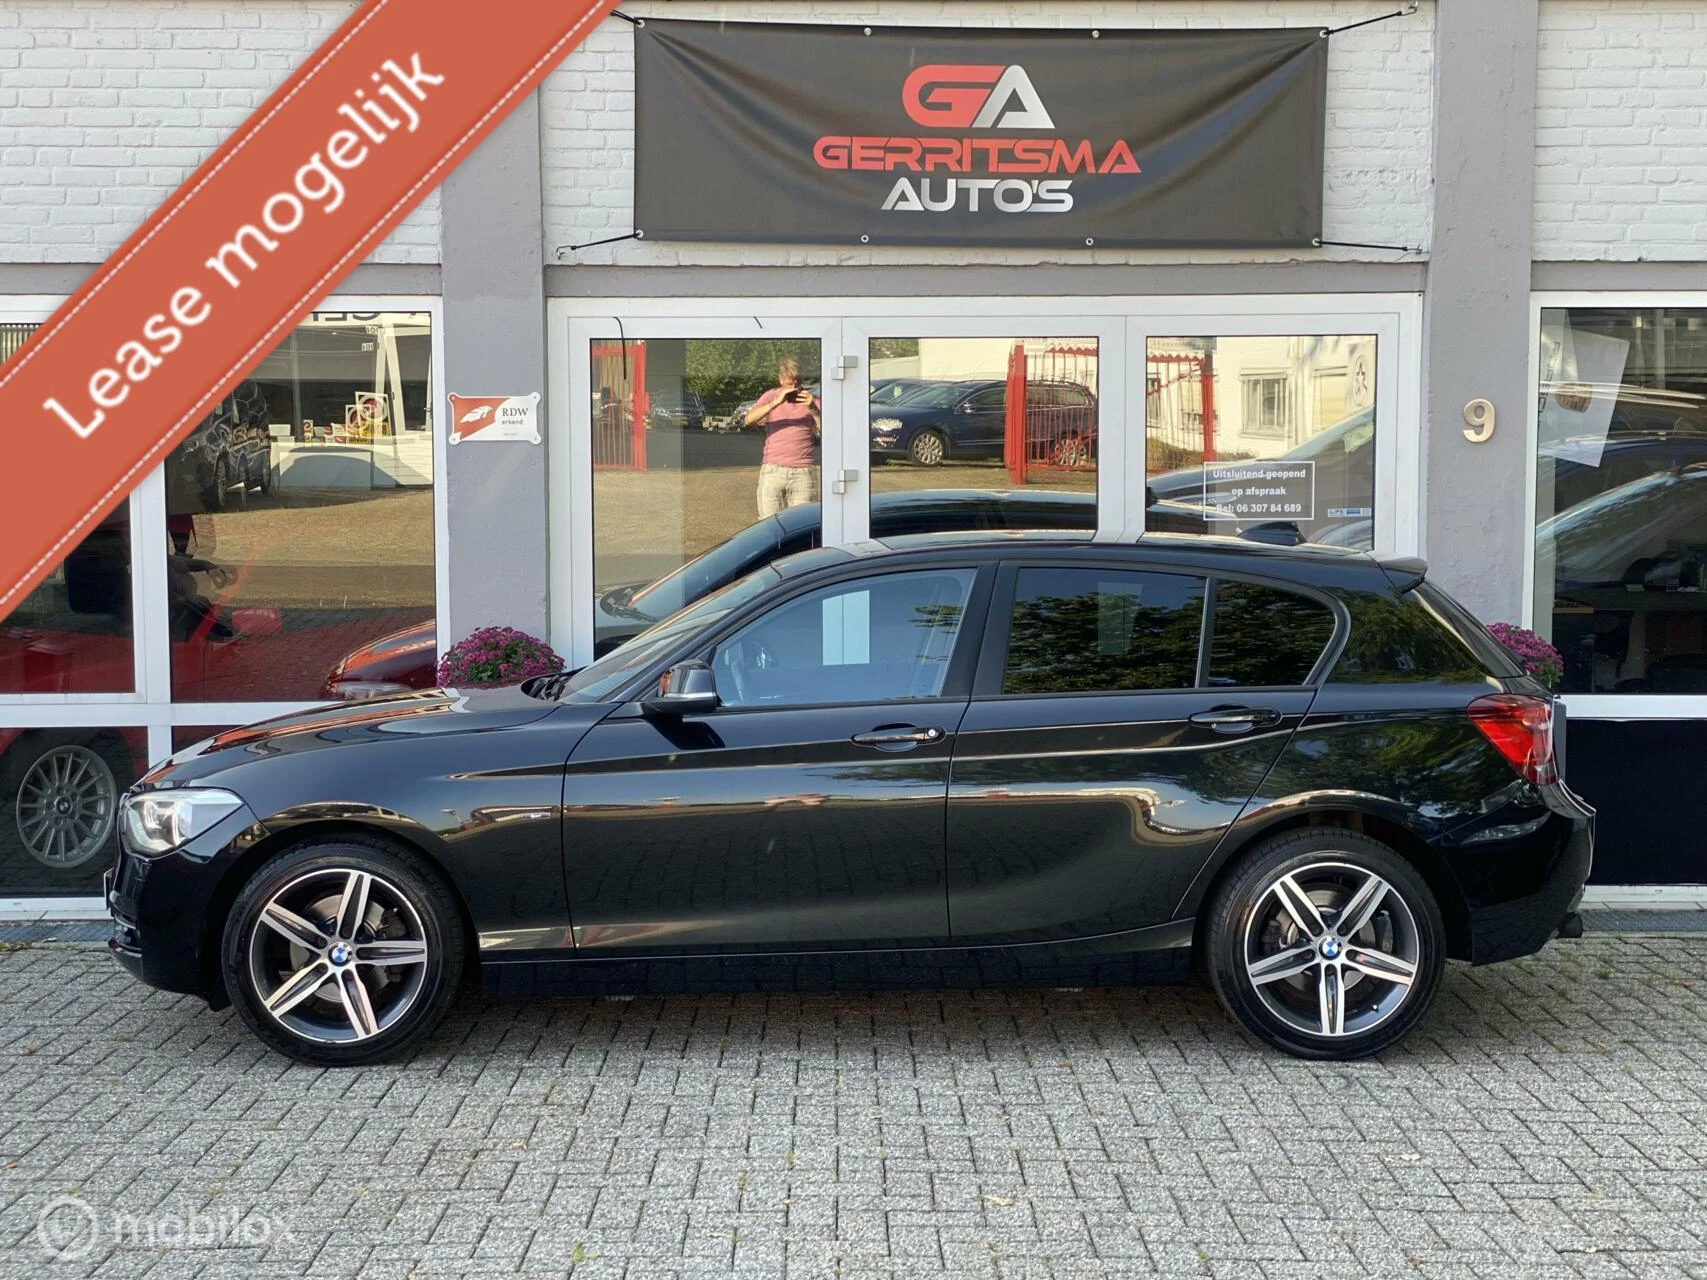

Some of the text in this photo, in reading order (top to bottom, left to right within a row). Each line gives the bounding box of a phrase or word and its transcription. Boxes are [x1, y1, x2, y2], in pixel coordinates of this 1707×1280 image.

[902, 64, 1055, 129] GA
[813, 136, 1142, 174] GERRITSMA
[881, 176, 1074, 213] AUTO'S
[502, 408, 529, 417] RDW
[1463, 399, 1496, 443] 9
[1212, 469, 1306, 480] Uitsluitend geopend
[1231, 487, 1286, 497] op afspraak
[1236, 504, 1248, 513] 06
[1250, 504, 1267, 513] 307
[1270, 504, 1282, 513] 84
[1284, 504, 1302, 513] 689
